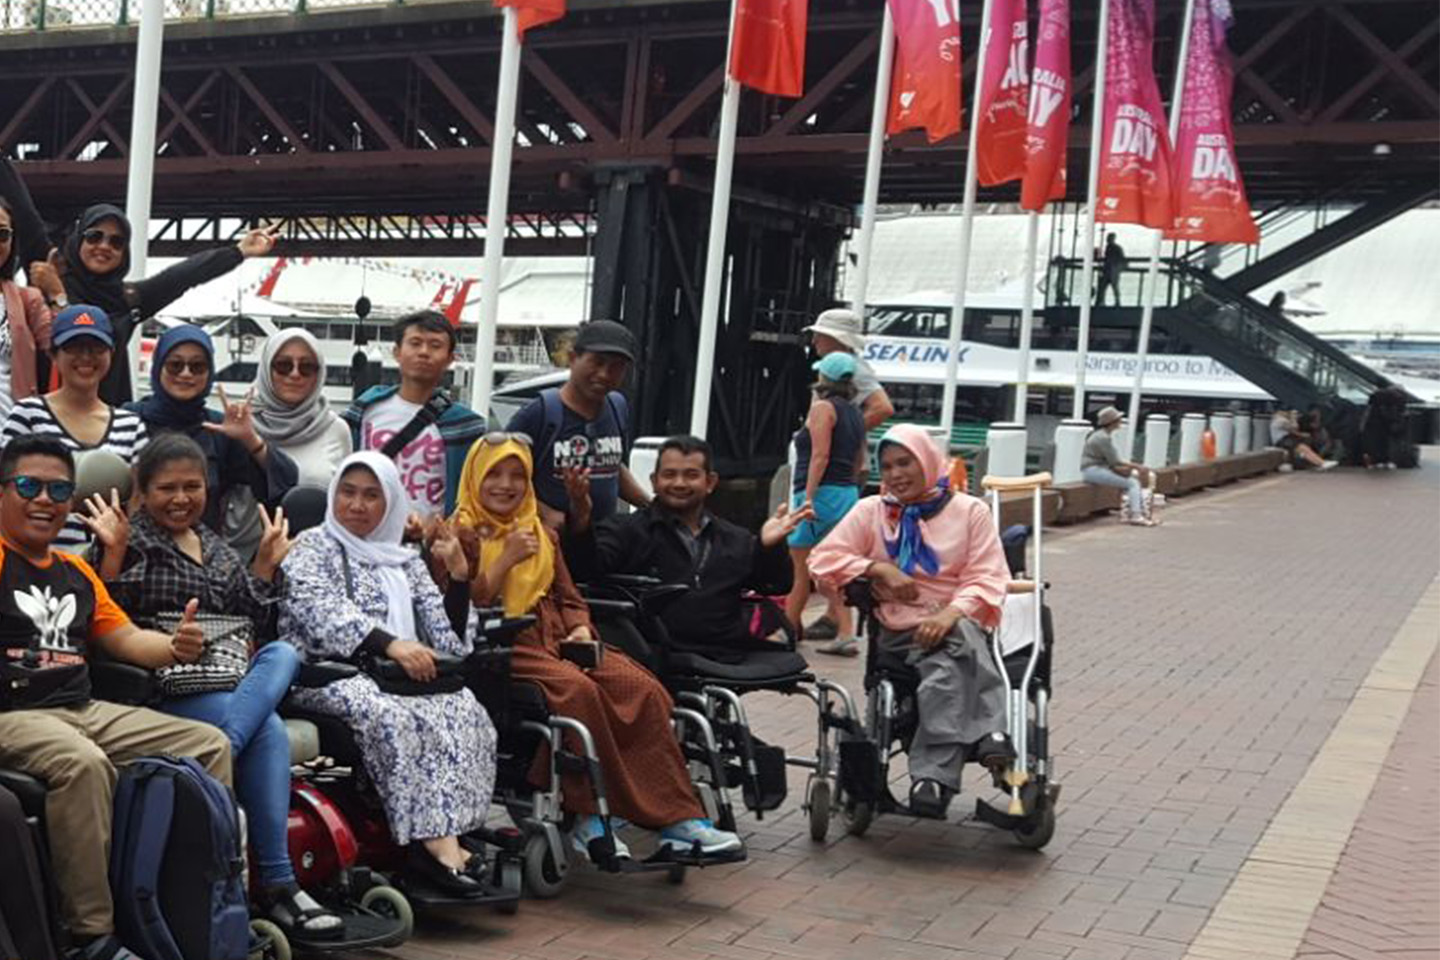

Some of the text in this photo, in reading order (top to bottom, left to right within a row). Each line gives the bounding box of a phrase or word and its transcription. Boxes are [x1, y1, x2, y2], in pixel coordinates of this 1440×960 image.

[1111, 118, 1157, 161] DAY
[1192, 147, 1237, 183] DA
[1185, 360, 1204, 375] to
